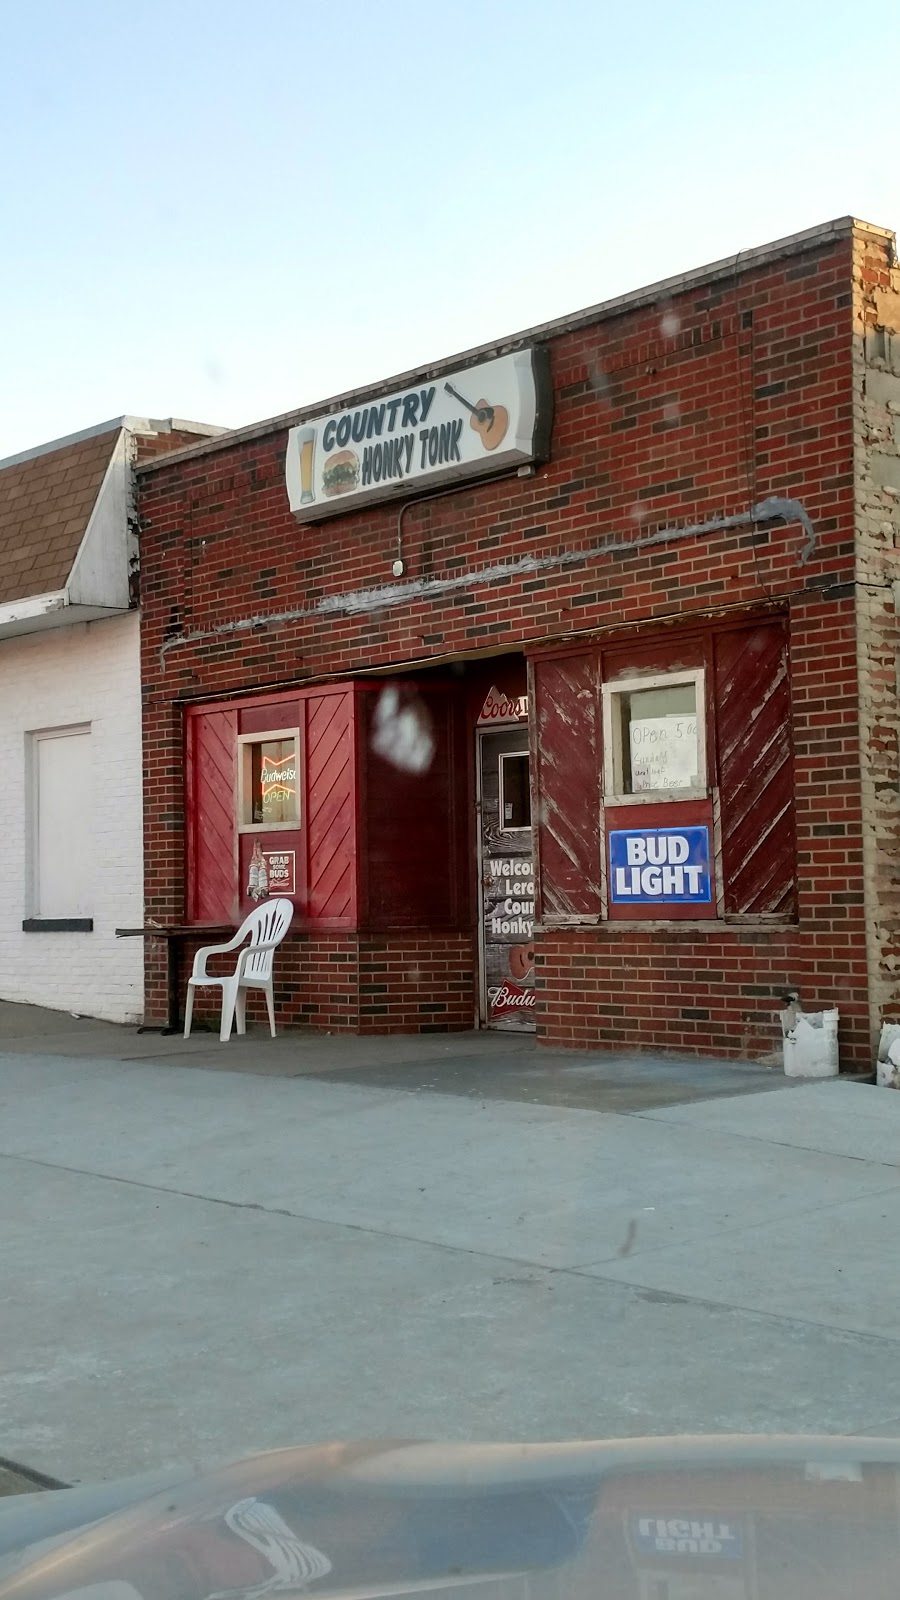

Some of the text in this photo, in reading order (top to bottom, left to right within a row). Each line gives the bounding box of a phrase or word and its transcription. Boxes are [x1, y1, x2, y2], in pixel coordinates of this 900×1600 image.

[322, 386, 436, 452] COUNTRY
[361, 418, 463, 486] HONKY TONK
[481, 695, 523, 719] Coors
[263, 790, 291, 804] OPEN
[269, 856, 290, 865] GRAB
[626, 836, 690, 866] BUD
[269, 869, 290, 878] BUDS
[616, 865, 704, 896] LIGHT
[492, 918, 534, 937] Honky
